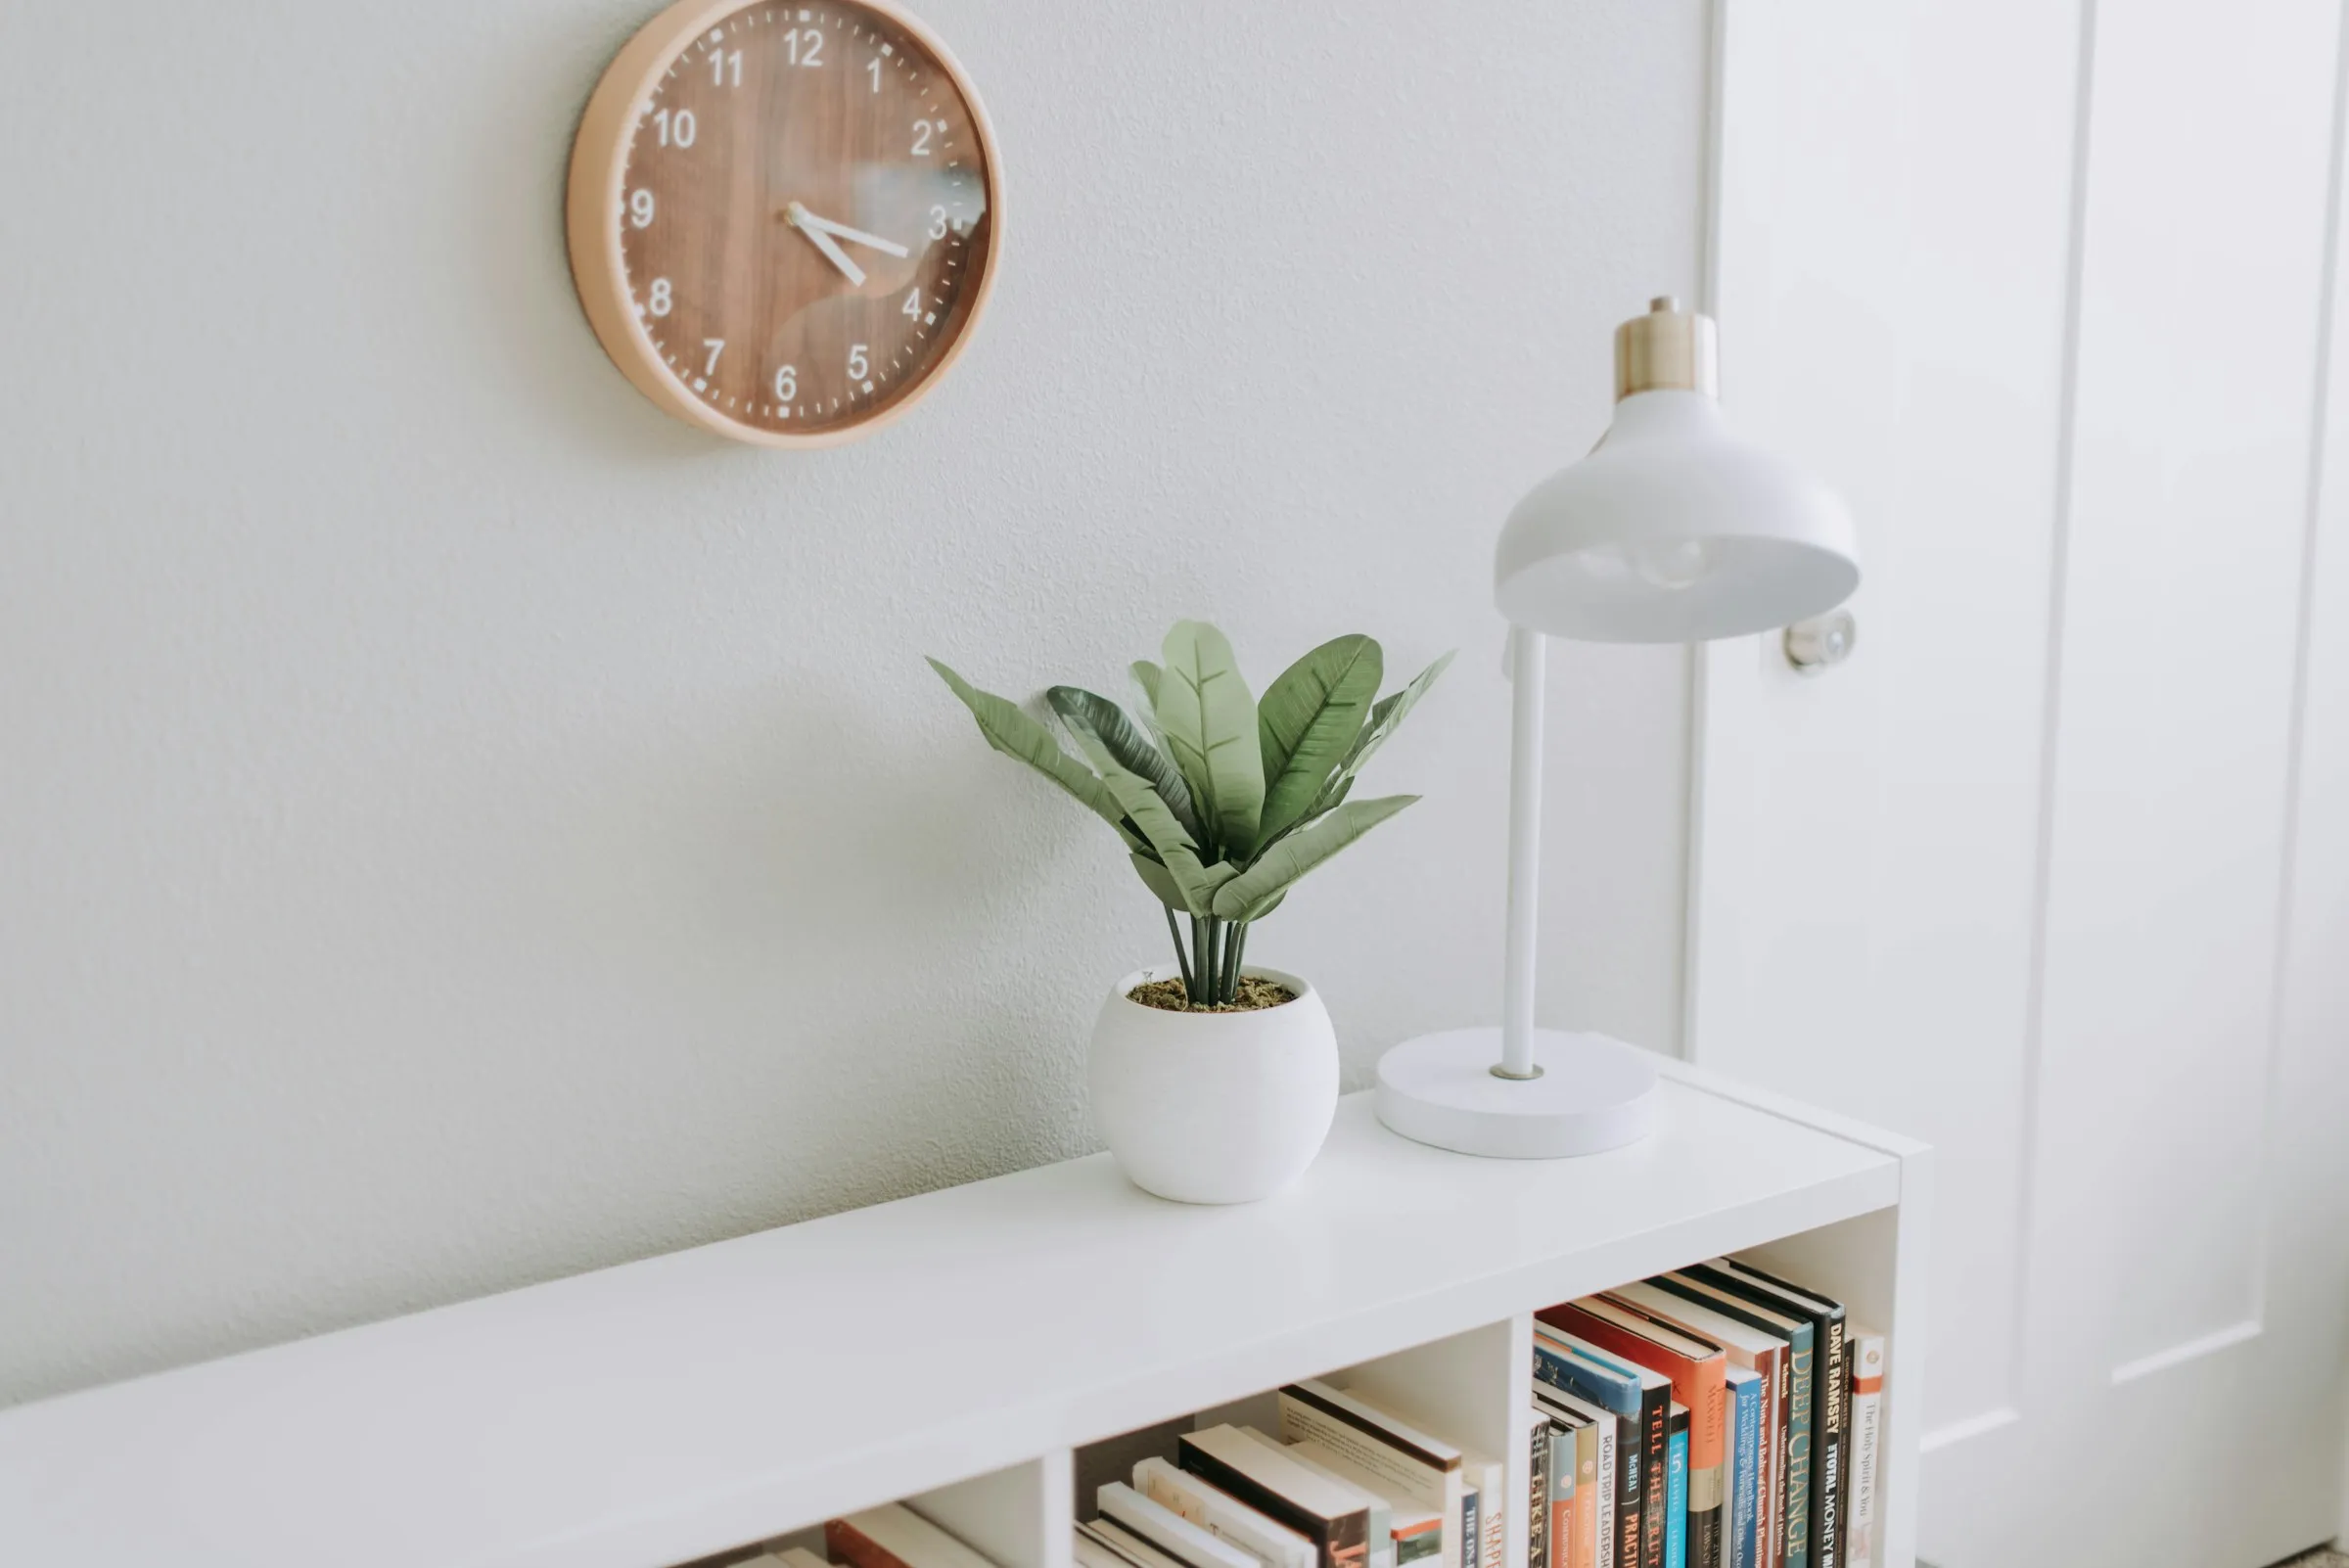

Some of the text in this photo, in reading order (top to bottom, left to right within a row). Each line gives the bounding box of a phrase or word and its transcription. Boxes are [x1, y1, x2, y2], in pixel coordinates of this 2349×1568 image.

[784, 28, 824, 68] 12
[708, 50, 744, 87] 11
[867, 57, 882, 93] 1
[654, 110, 696, 148] 10
[910, 119, 932, 156] 2
[630, 189, 655, 228] 9
[928, 205, 947, 240] 3
[649, 278, 672, 317] 8
[901, 287, 922, 323] 4
[703, 339, 725, 376] 7
[849, 345, 869, 381] 5
[775, 365, 798, 401] 6
[1761, 1375, 1770, 1397] The
[1827, 1322, 1842, 1435] DAVE RAMSEY
[1652, 1406, 1663, 1455] TELL
[1760, 1398, 1769, 1426] Nuts
[1602, 1434, 1613, 1471] ROAD
[1759, 1427, 1768, 1446] and
[1788, 1347, 1813, 1557] DEEP CHANGE
[1672, 1453, 1681, 1474] 5
[1758, 1448, 1768, 1474] Bolts
[1825, 1452, 1837, 1494] TOTAL
[1602, 1472, 1612, 1502] TRIP
[1651, 1462, 1661, 1503] THE
[1532, 1473, 1543, 1560] LIKE A
[1758, 1486, 1767, 1526] Church
[1823, 1494, 1836, 1551] MONEY
[1625, 1512, 1639, 1568] PRACTI
